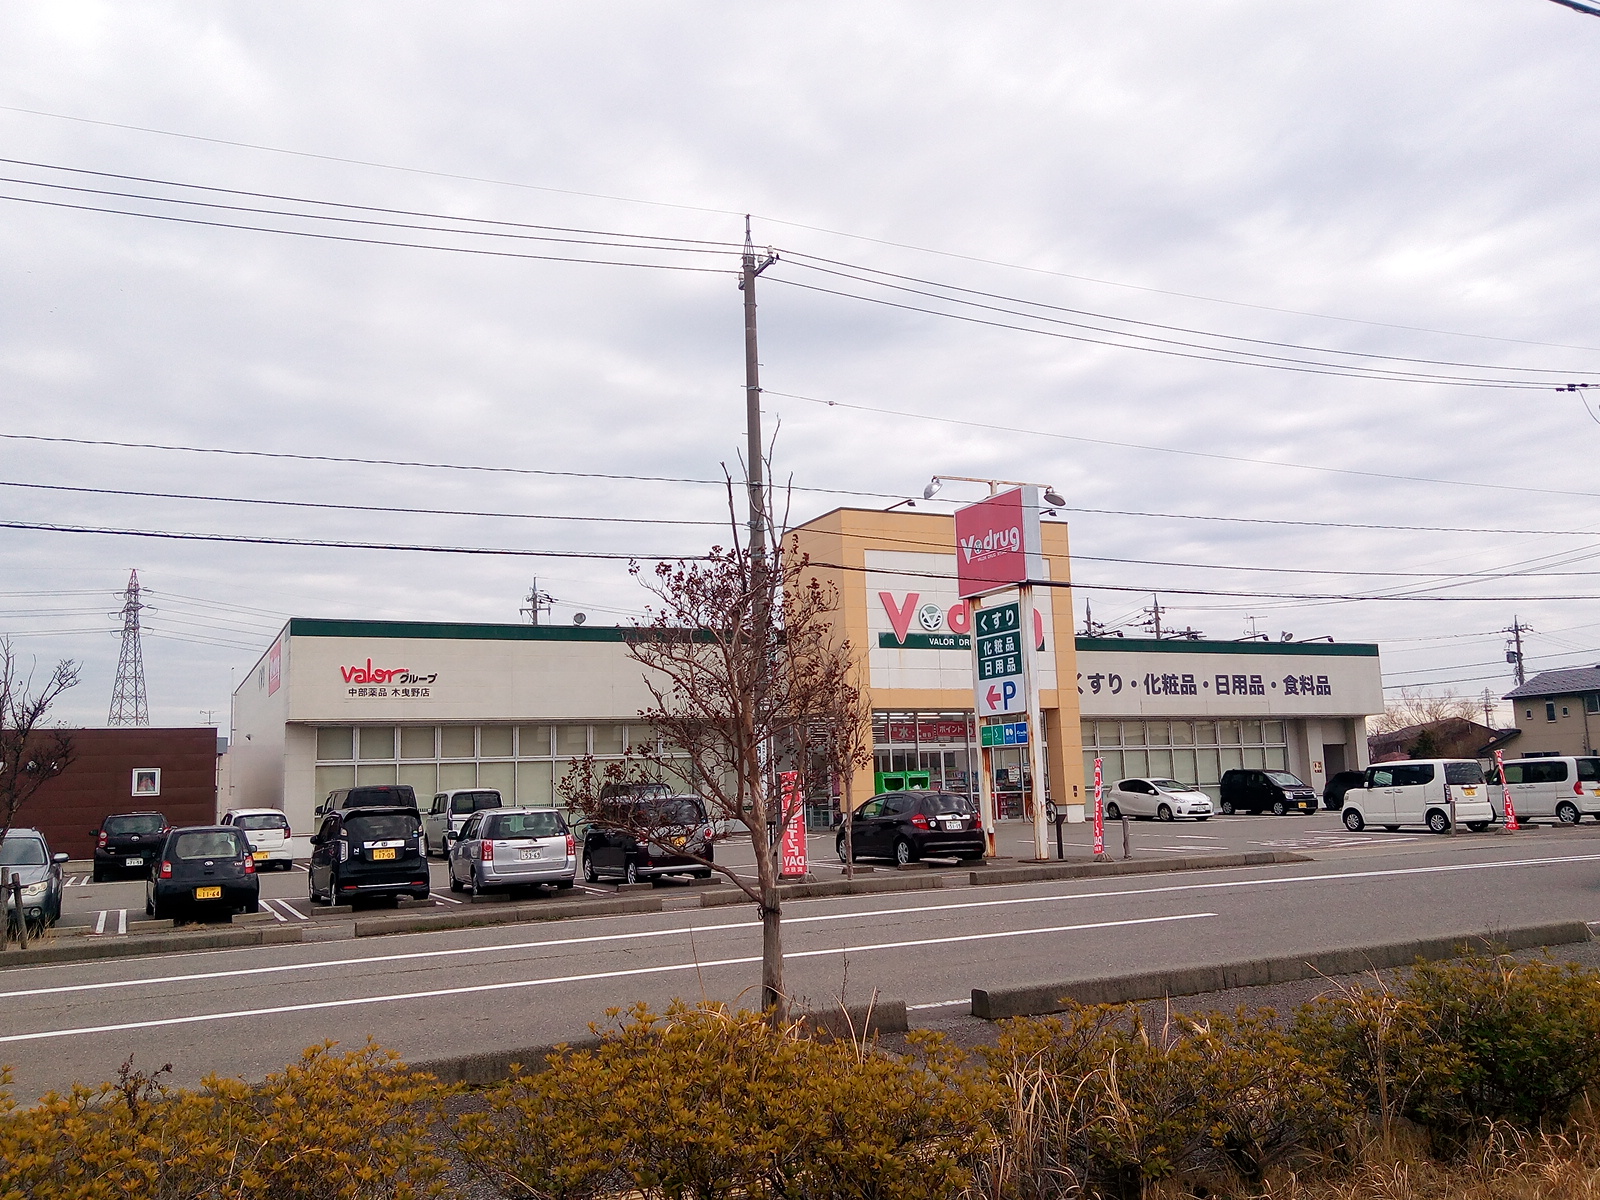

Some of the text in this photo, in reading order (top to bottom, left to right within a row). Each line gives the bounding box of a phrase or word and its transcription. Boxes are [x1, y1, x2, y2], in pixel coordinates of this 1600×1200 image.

[980, 609, 1014, 631] くすり
[929, 638, 955, 646] VALOR
[983, 636, 1014, 656] 化粧品
[985, 657, 1016, 676] 日用品
[400, 673, 438, 684] グループ
[348, 687, 430, 697] 中部薬品 木曳野店
[1003, 681, 1017, 710] P
